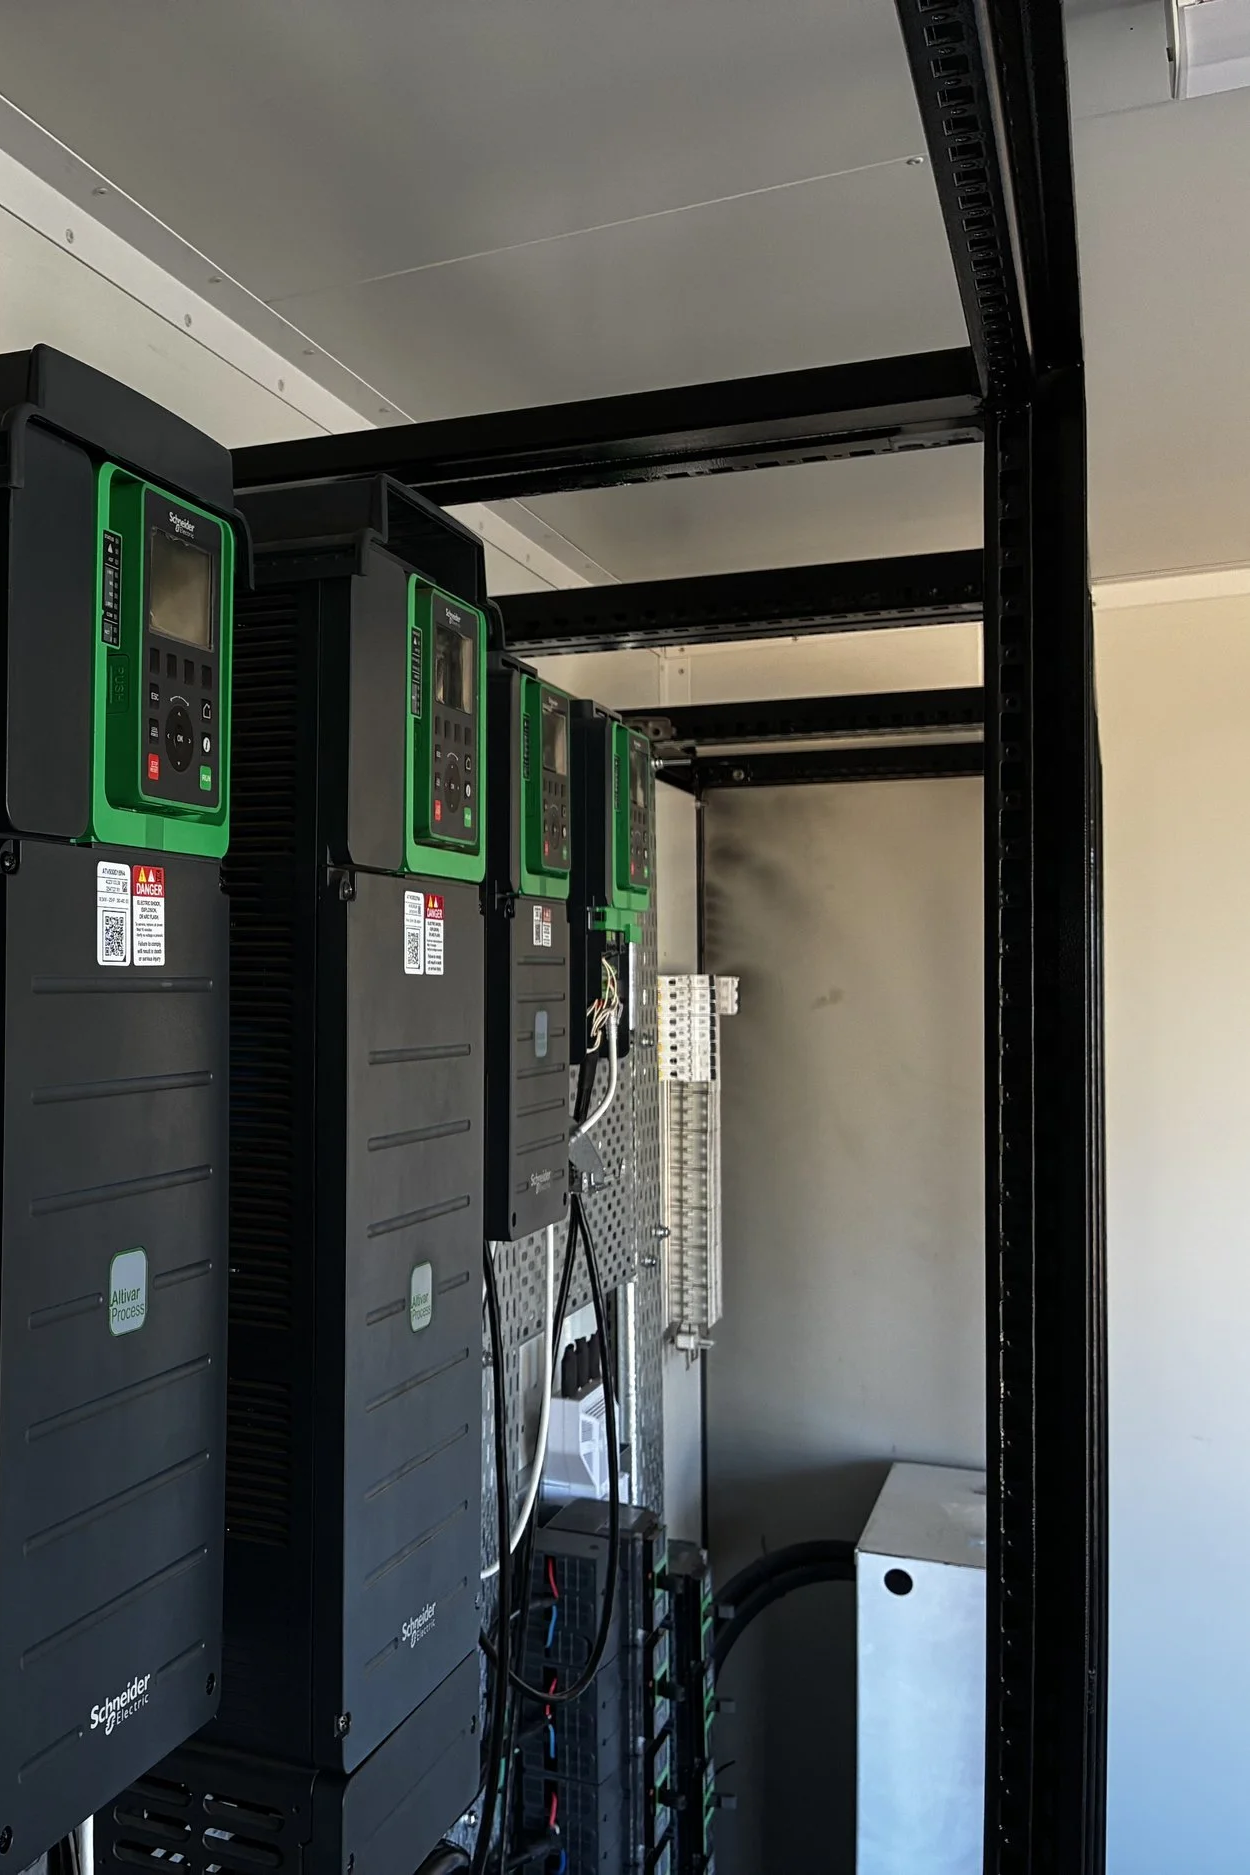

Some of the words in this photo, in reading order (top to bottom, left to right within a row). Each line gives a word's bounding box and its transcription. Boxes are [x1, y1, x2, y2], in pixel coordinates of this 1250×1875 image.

[169, 511, 195, 532] Schneider
[177, 734, 184, 743] OK
[201, 774, 211, 782] RUN
[136, 883, 163, 896] DANGER
[426, 908, 442, 919] DANGER
[111, 1287, 140, 1307] Altivar
[111, 1303, 145, 1324] Process
[402, 1602, 436, 1641] Schneider
[90, 1673, 150, 1729] Schneider
[116, 1693, 150, 1725] Electric
